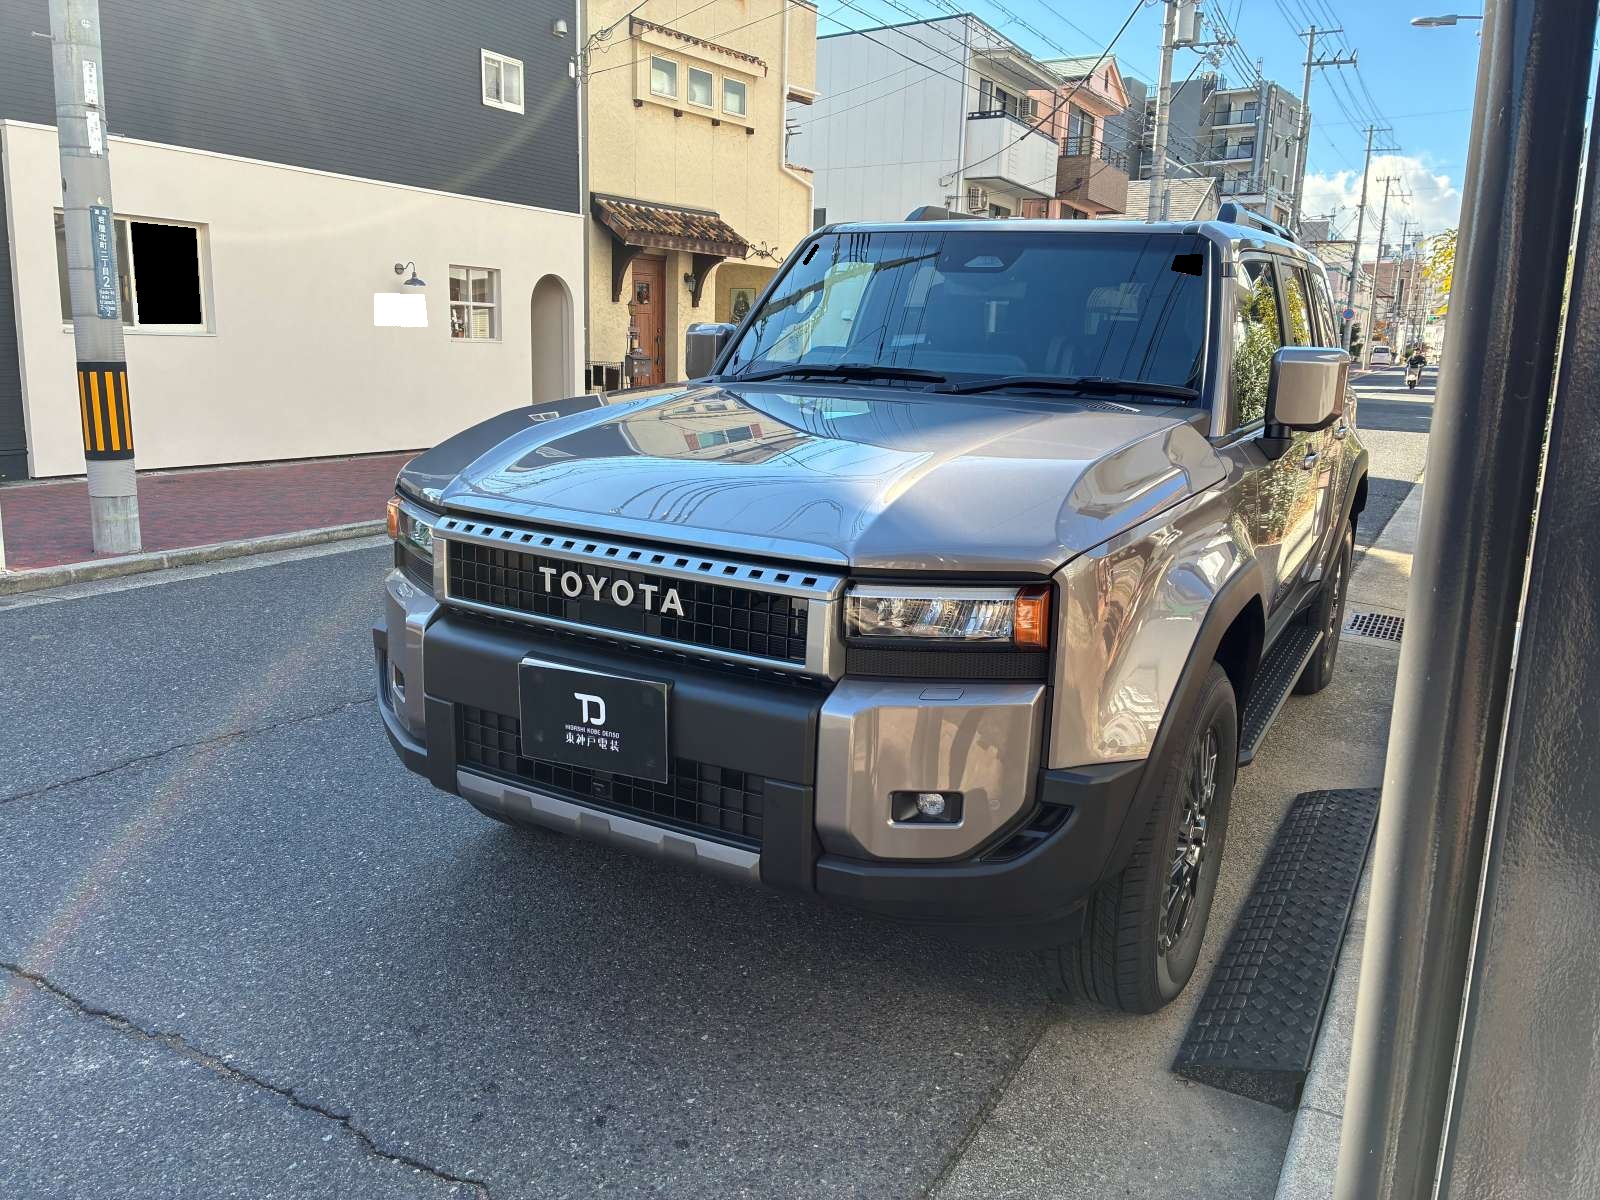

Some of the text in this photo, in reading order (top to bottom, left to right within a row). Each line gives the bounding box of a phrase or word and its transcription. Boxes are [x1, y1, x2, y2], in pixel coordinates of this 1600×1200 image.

[539, 566, 684, 617] TOYOTA
[565, 731, 620, 752] 東神戸電装
[586, 727, 601, 736] KOBE
